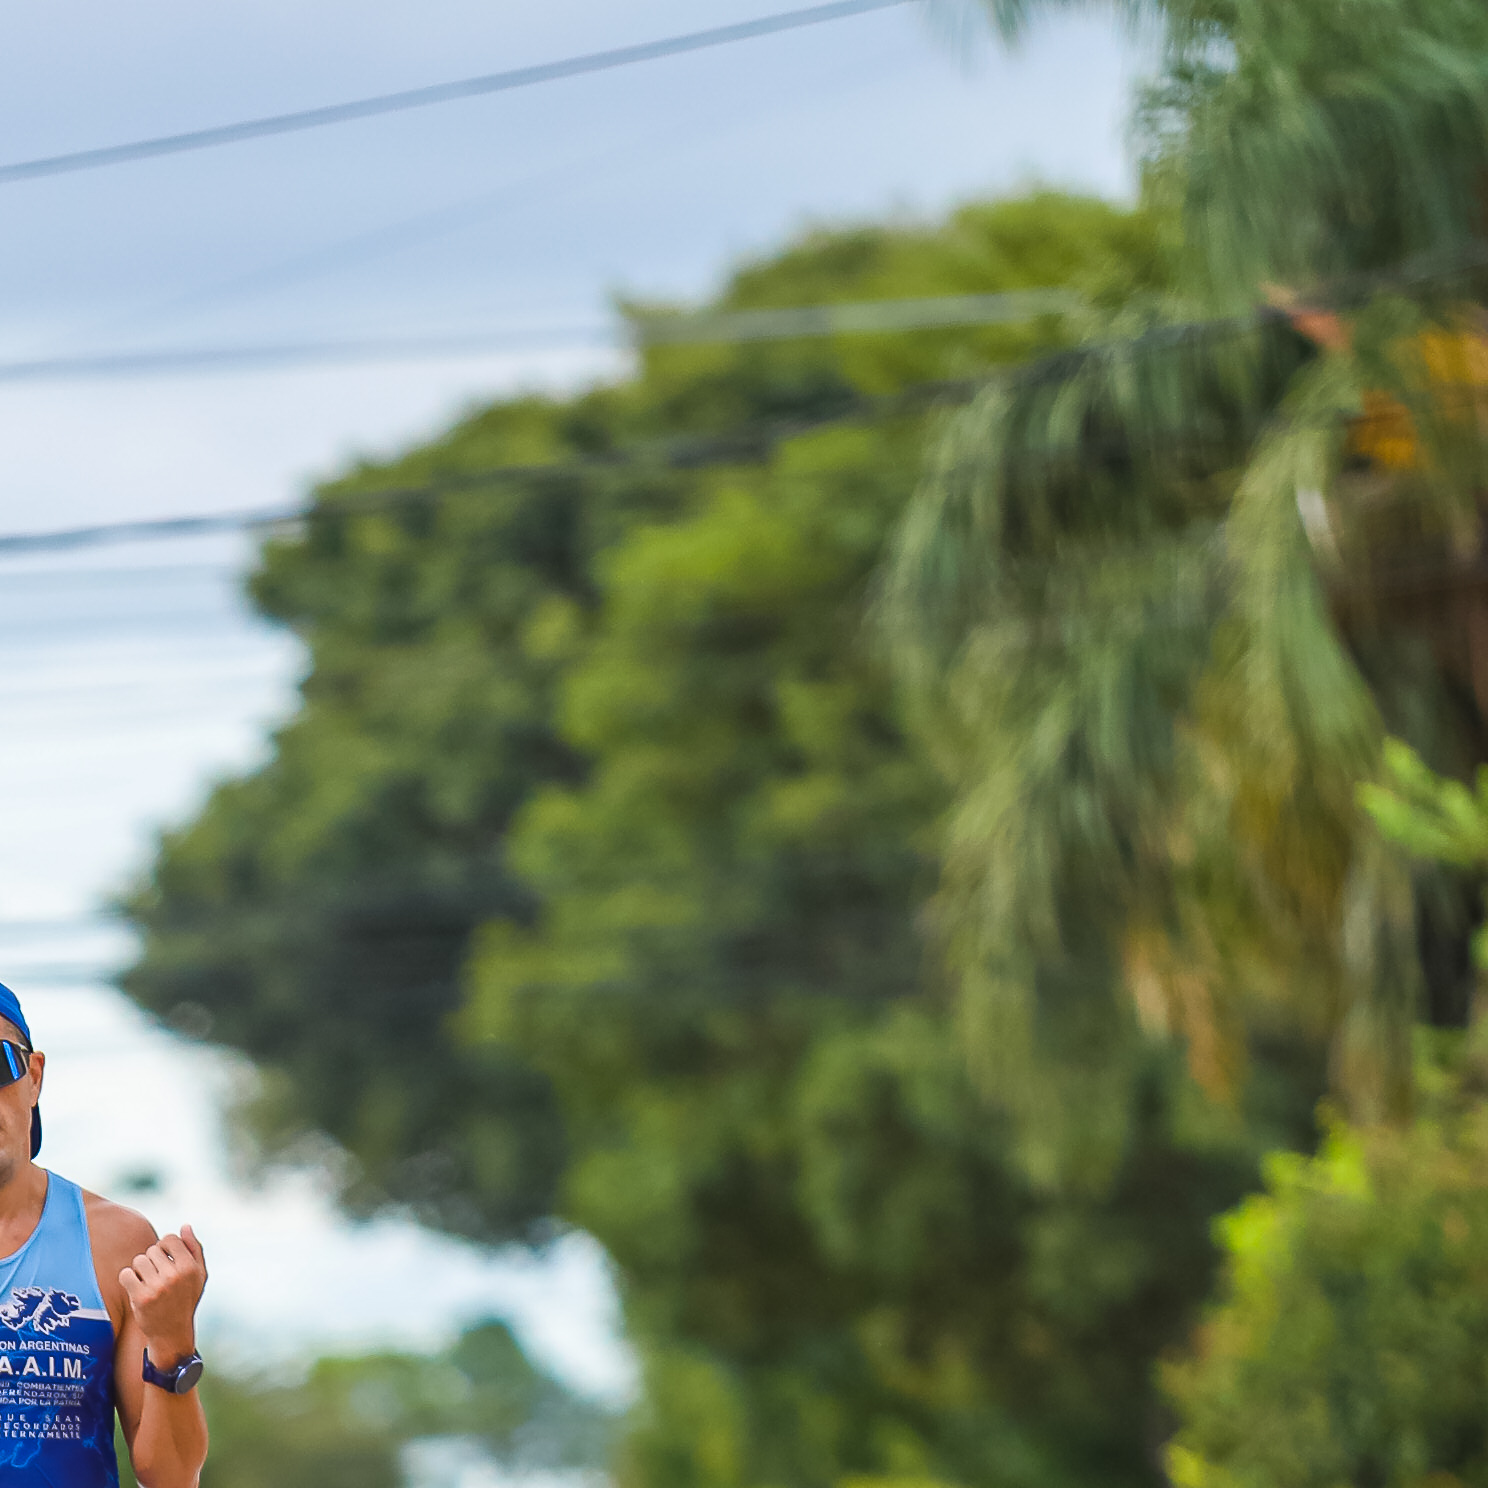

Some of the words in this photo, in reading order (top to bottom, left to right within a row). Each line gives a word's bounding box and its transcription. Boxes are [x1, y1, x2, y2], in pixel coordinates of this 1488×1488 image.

[19, 1340, 90, 1355] ARGENTINAS
[18, 1397, 38, 1406] POR
[45, 1414, 81, 1423] SEAN
